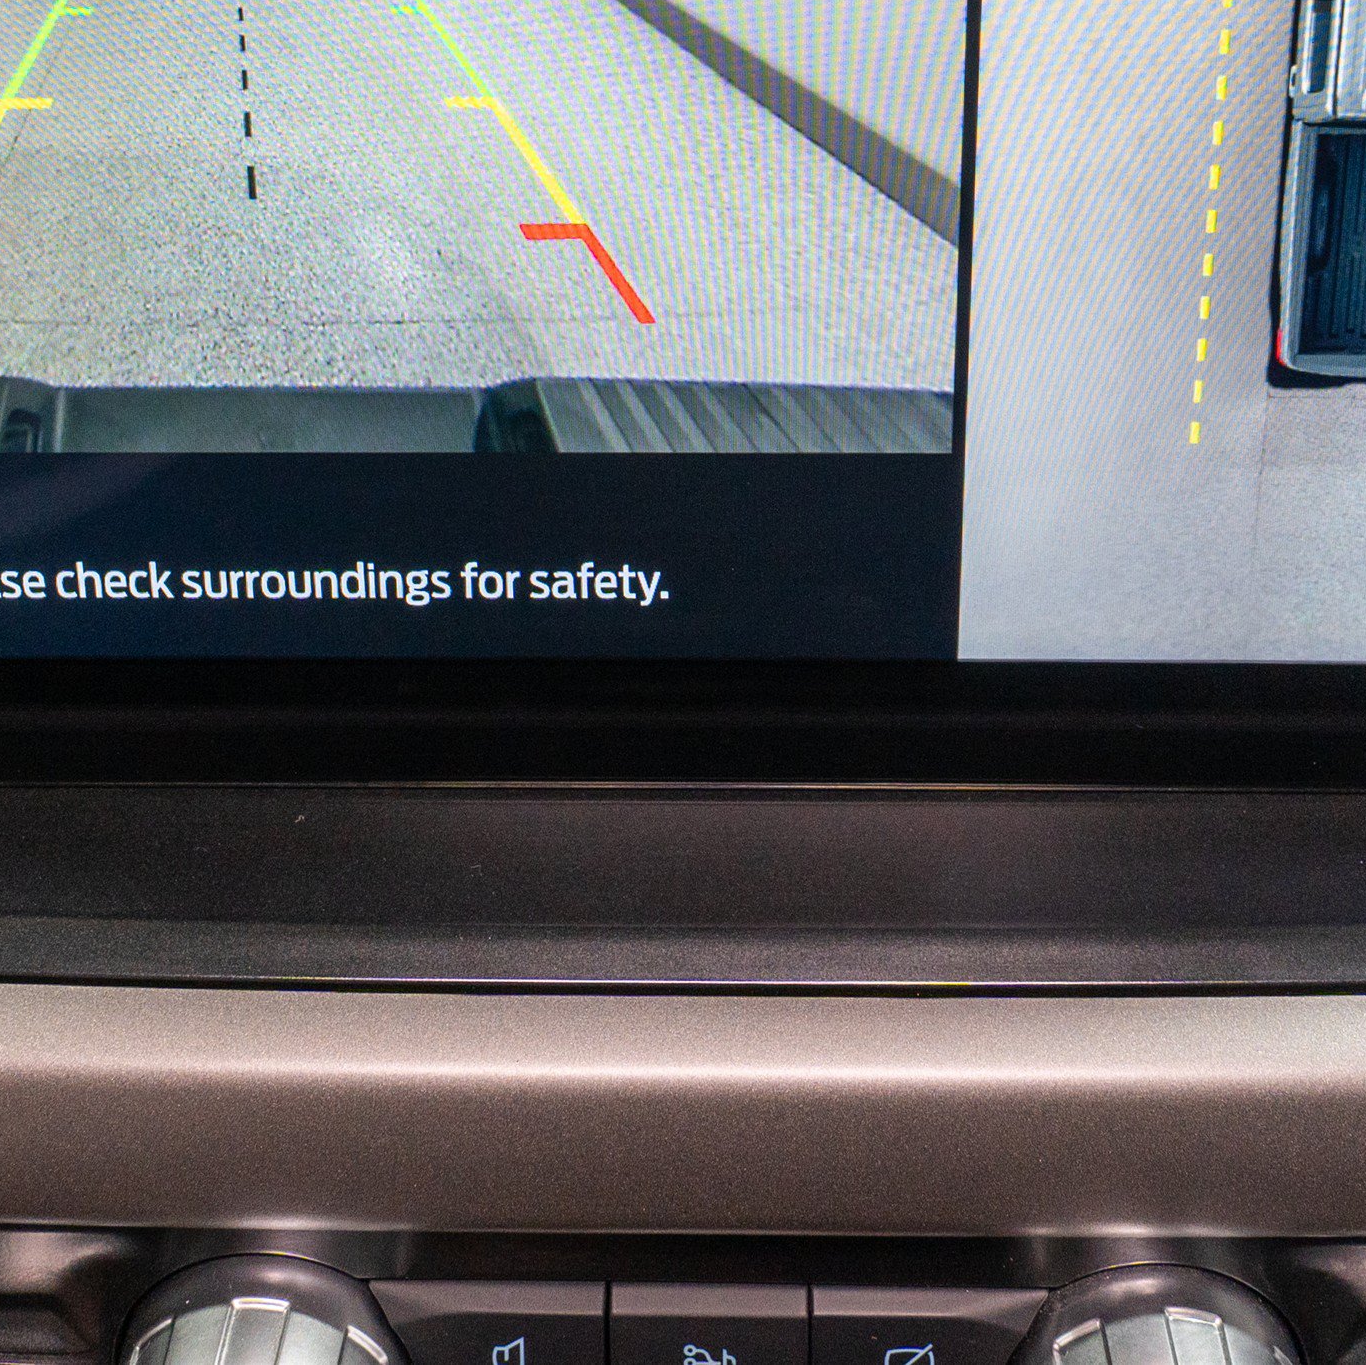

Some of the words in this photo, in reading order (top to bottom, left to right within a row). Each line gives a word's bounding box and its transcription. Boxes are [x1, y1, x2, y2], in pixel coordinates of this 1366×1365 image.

[55, 561, 175, 599] check
[181, 561, 452, 607] surroundings
[460, 561, 520, 599] for
[529, 561, 670, 607] safety.
